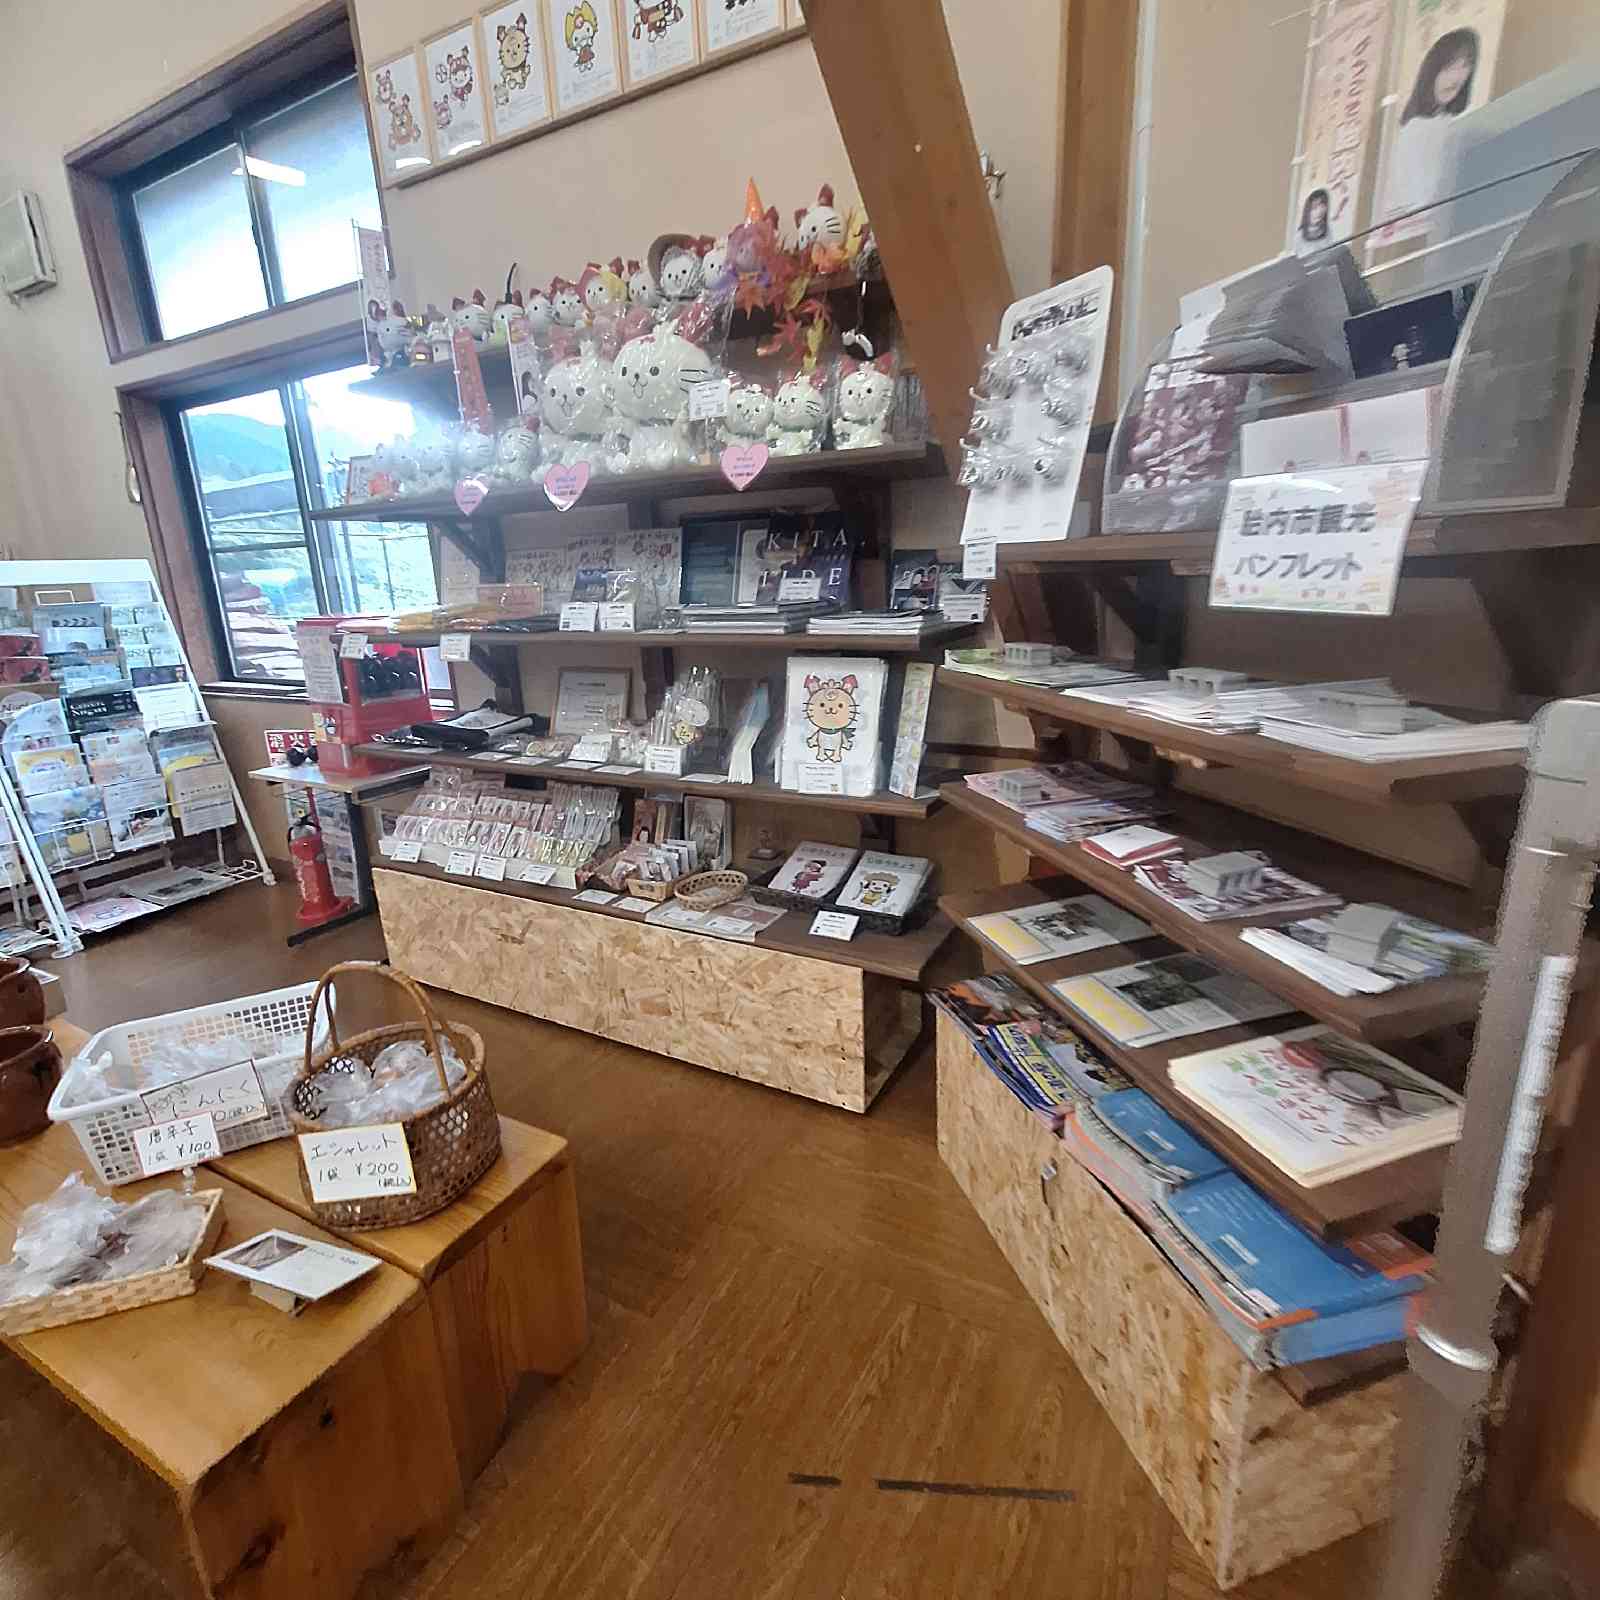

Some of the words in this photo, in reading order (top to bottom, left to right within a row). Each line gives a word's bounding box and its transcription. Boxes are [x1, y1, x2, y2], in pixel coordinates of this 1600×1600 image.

[768, 528, 847, 552] KITA
[1234, 551, 1363, 581] パンフレット
[311, 1132, 398, 1161] エシャレット
[354, 1161, 400, 1177] ¥200
